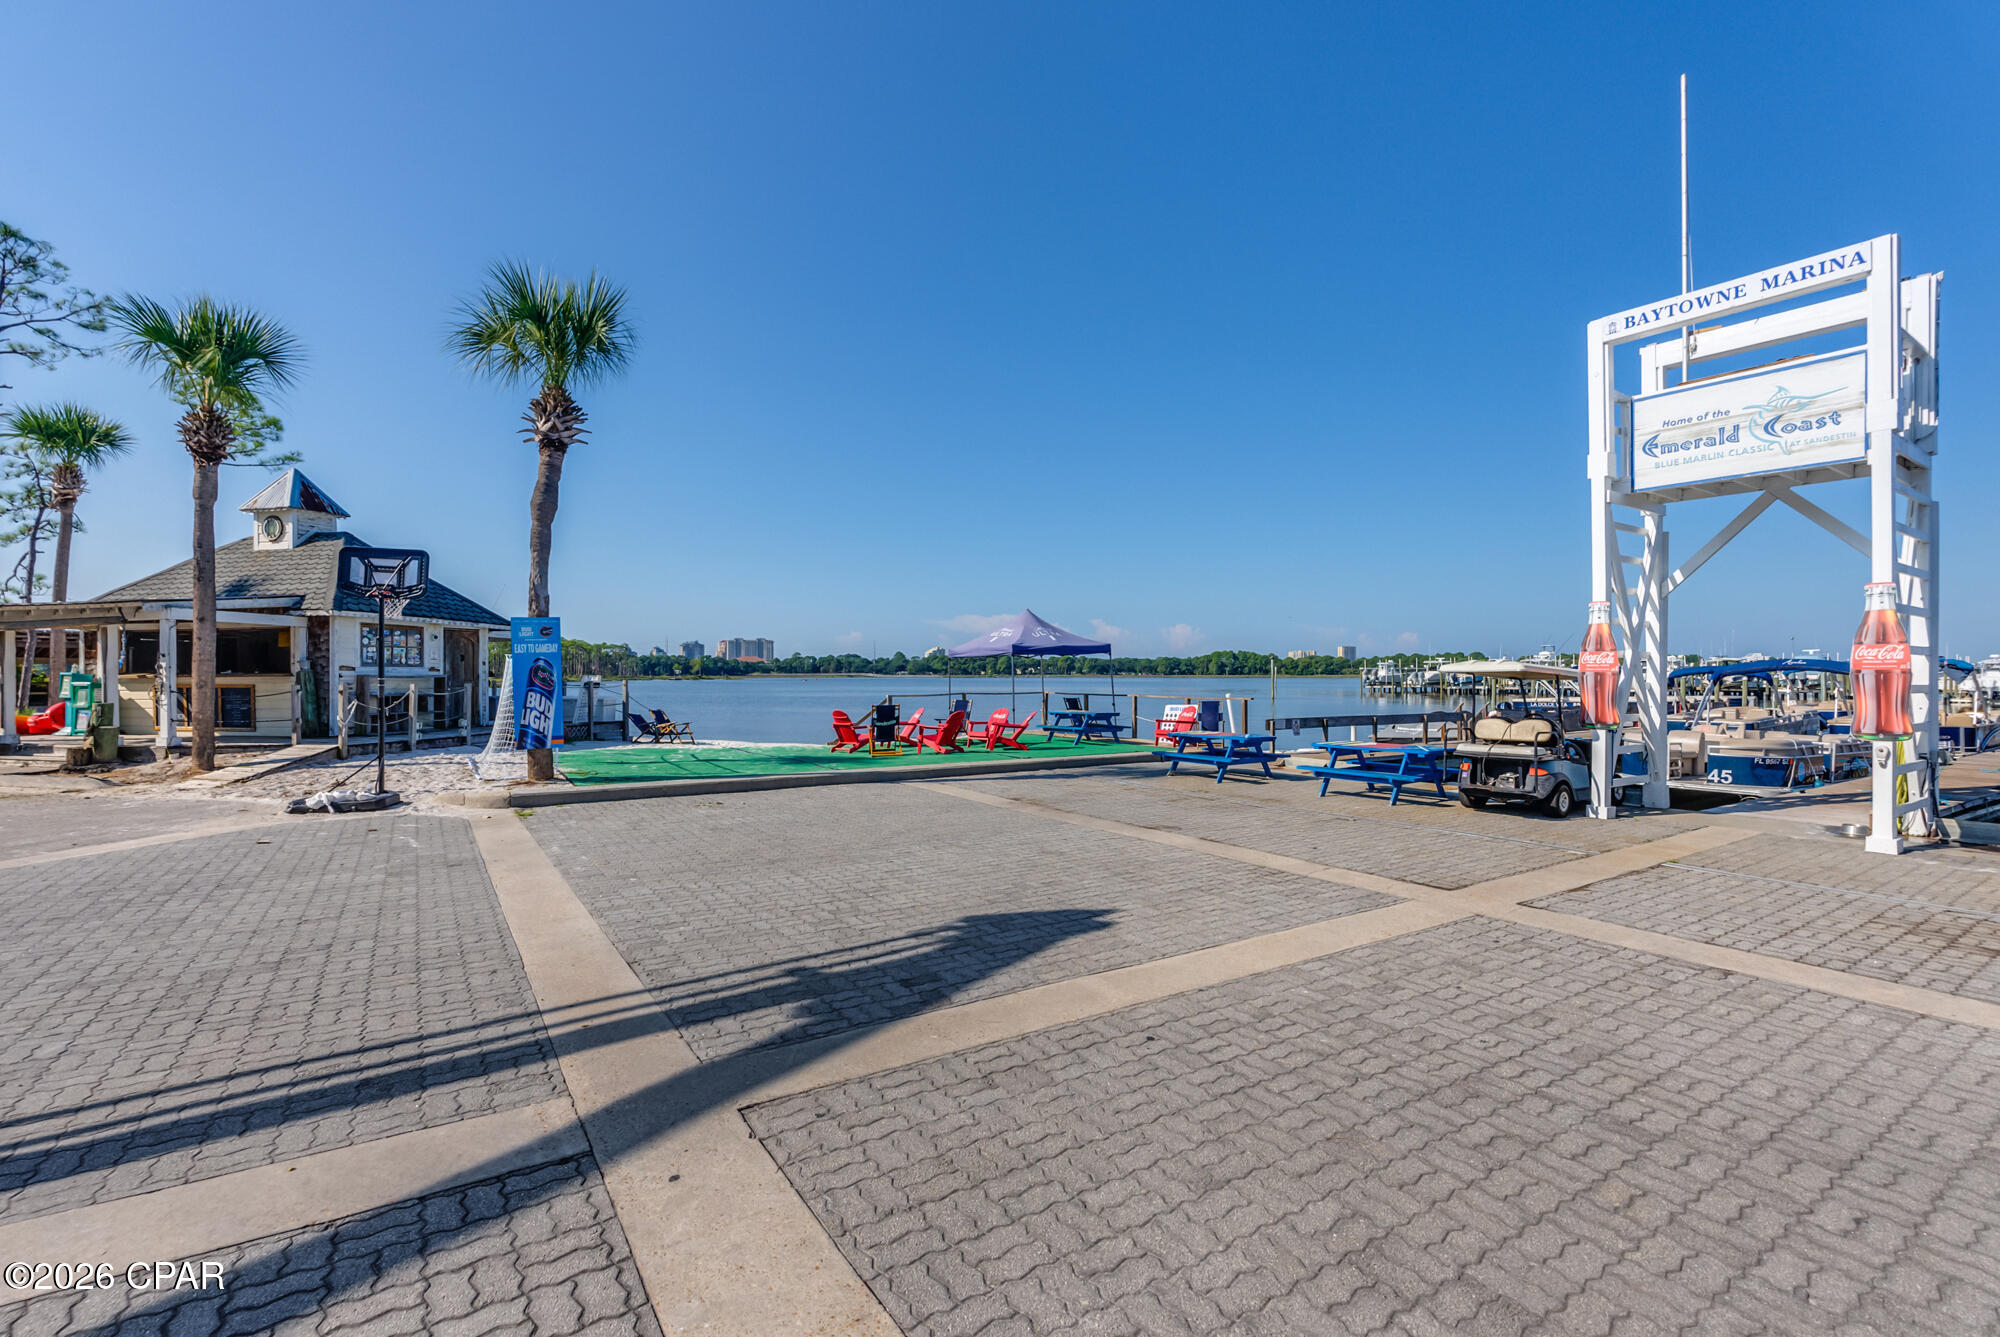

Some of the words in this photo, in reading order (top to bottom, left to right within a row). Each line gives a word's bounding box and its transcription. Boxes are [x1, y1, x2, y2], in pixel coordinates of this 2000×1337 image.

[1623, 284, 1747, 330] BAYTOWNE
[1760, 250, 1867, 292] MARINA
[1662, 416, 1693, 428] Home
[1696, 411, 1710, 422] of
[1712, 409, 1731, 419] the
[1641, 423, 1741, 459] Emerald
[1763, 410, 1842, 438] Coast
[1654, 458, 1680, 469] BLUE
[1682, 450, 1725, 465] MARLIN
[1728, 443, 1775, 457] CLASSIC
[1790, 440, 1801, 448] AT
[1803, 431, 1857, 446] SANDESTIN
[513, 643, 527, 654] EASY
[528, 643, 535, 653] TO
[535, 643, 559, 653] GAMEDAY
[1581, 651, 1615, 664] Coca-Cola
[1855, 644, 1905, 660] Coca-Cola
[526, 691, 553, 718] BUD
[520, 708, 550, 736] LIGH
[1754, 757, 1763, 765] FL
[1707, 768, 1733, 784] 45
